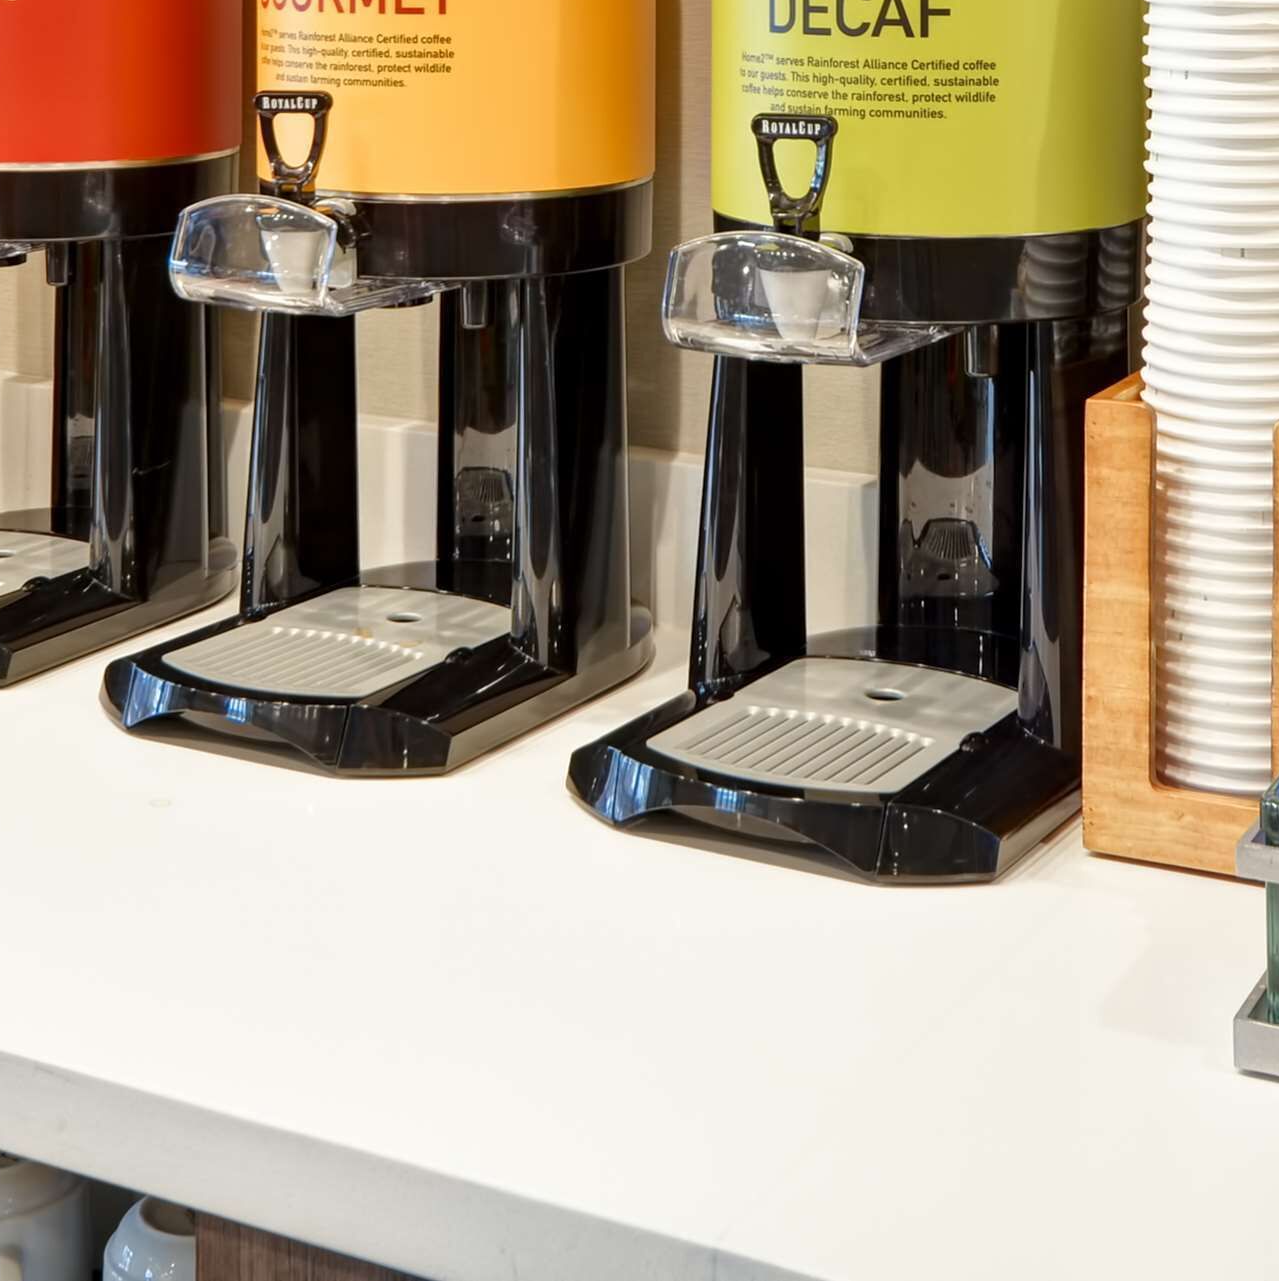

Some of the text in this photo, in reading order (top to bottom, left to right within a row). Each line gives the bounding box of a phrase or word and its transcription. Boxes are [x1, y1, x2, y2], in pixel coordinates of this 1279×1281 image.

[376, 33, 418, 44] Certified
[420, 34, 453, 45] coffee
[394, 48, 456, 59] sustainable
[377, 63, 412, 75] protect
[414, 63, 453, 74] wildlife
[776, 56, 997, 71] serves Rainforest Alliance Certified coffee
[791, 71, 810, 82] This
[933, 76, 1000, 87] sustainable
[786, 88, 829, 99] conserve
[831, 89, 849, 100] the
[911, 92, 952, 105] protect
[955, 91, 996, 103] wildlife
[787, 104, 821, 114] sustain
[824, 105, 866, 120] farming
[868, 107, 947, 119] communities.
